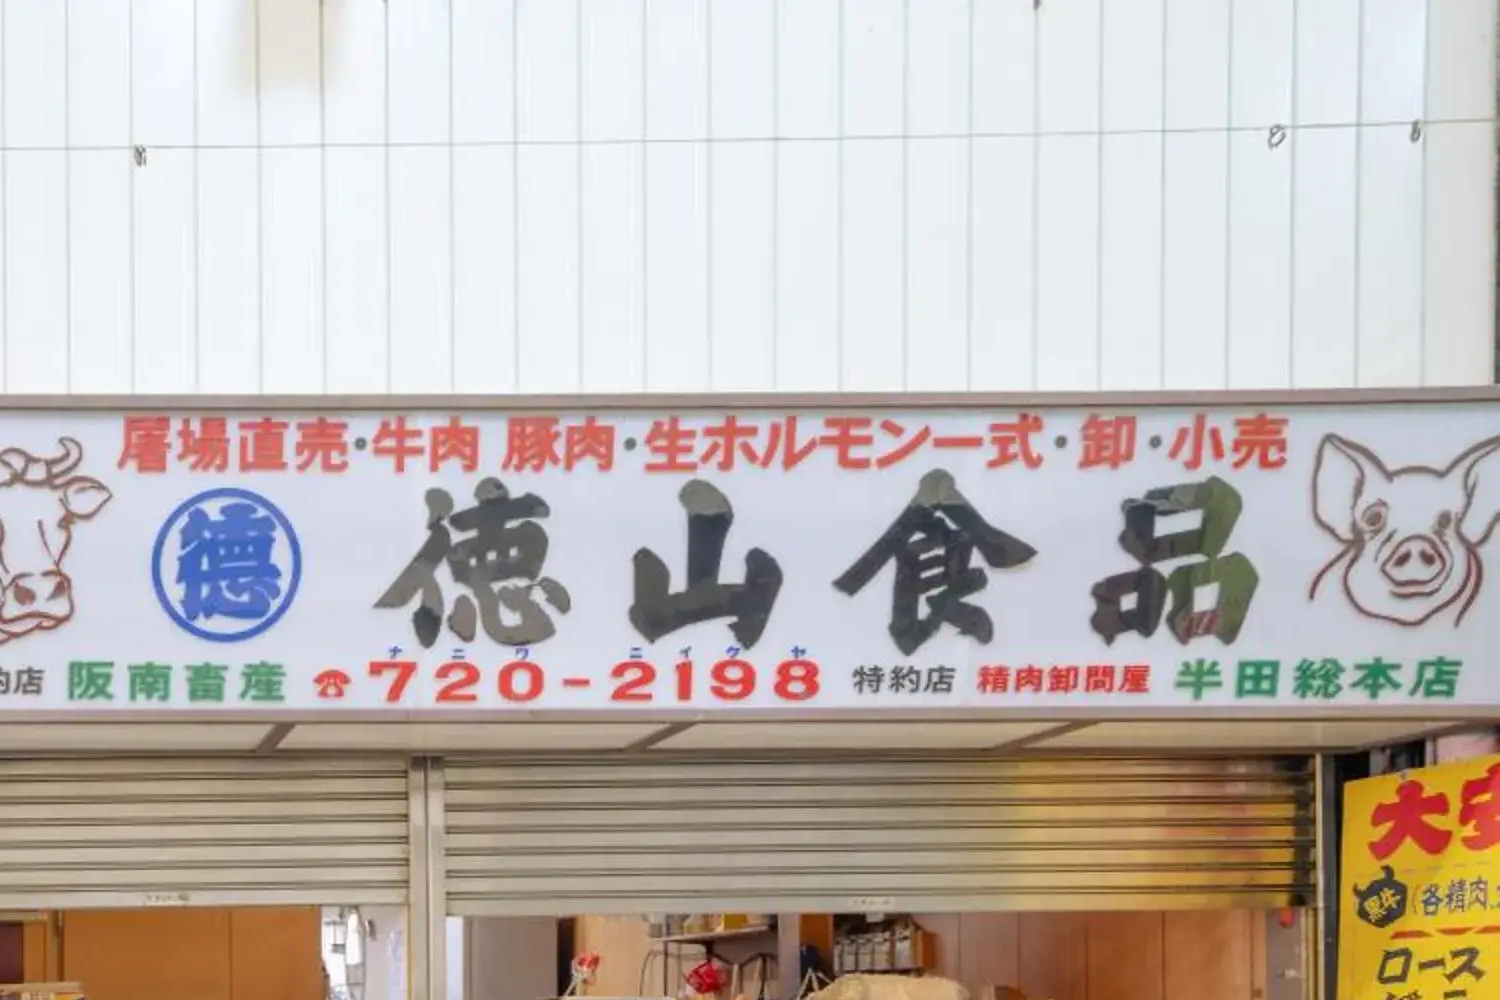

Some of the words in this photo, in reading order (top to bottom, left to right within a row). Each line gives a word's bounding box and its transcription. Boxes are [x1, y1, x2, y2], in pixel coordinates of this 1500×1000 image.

[372, 468, 1259, 656] 徳山食品
[67, 661, 287, 702] 阪南畜産
[368, 658, 821, 703] 720-2198
[851, 664, 957, 694] 特約店
[976, 664, 1152, 694] 精肉卸問屋
[1174, 656, 1463, 700] 半田総本店
[1377, 946, 1485, 985] ロース
